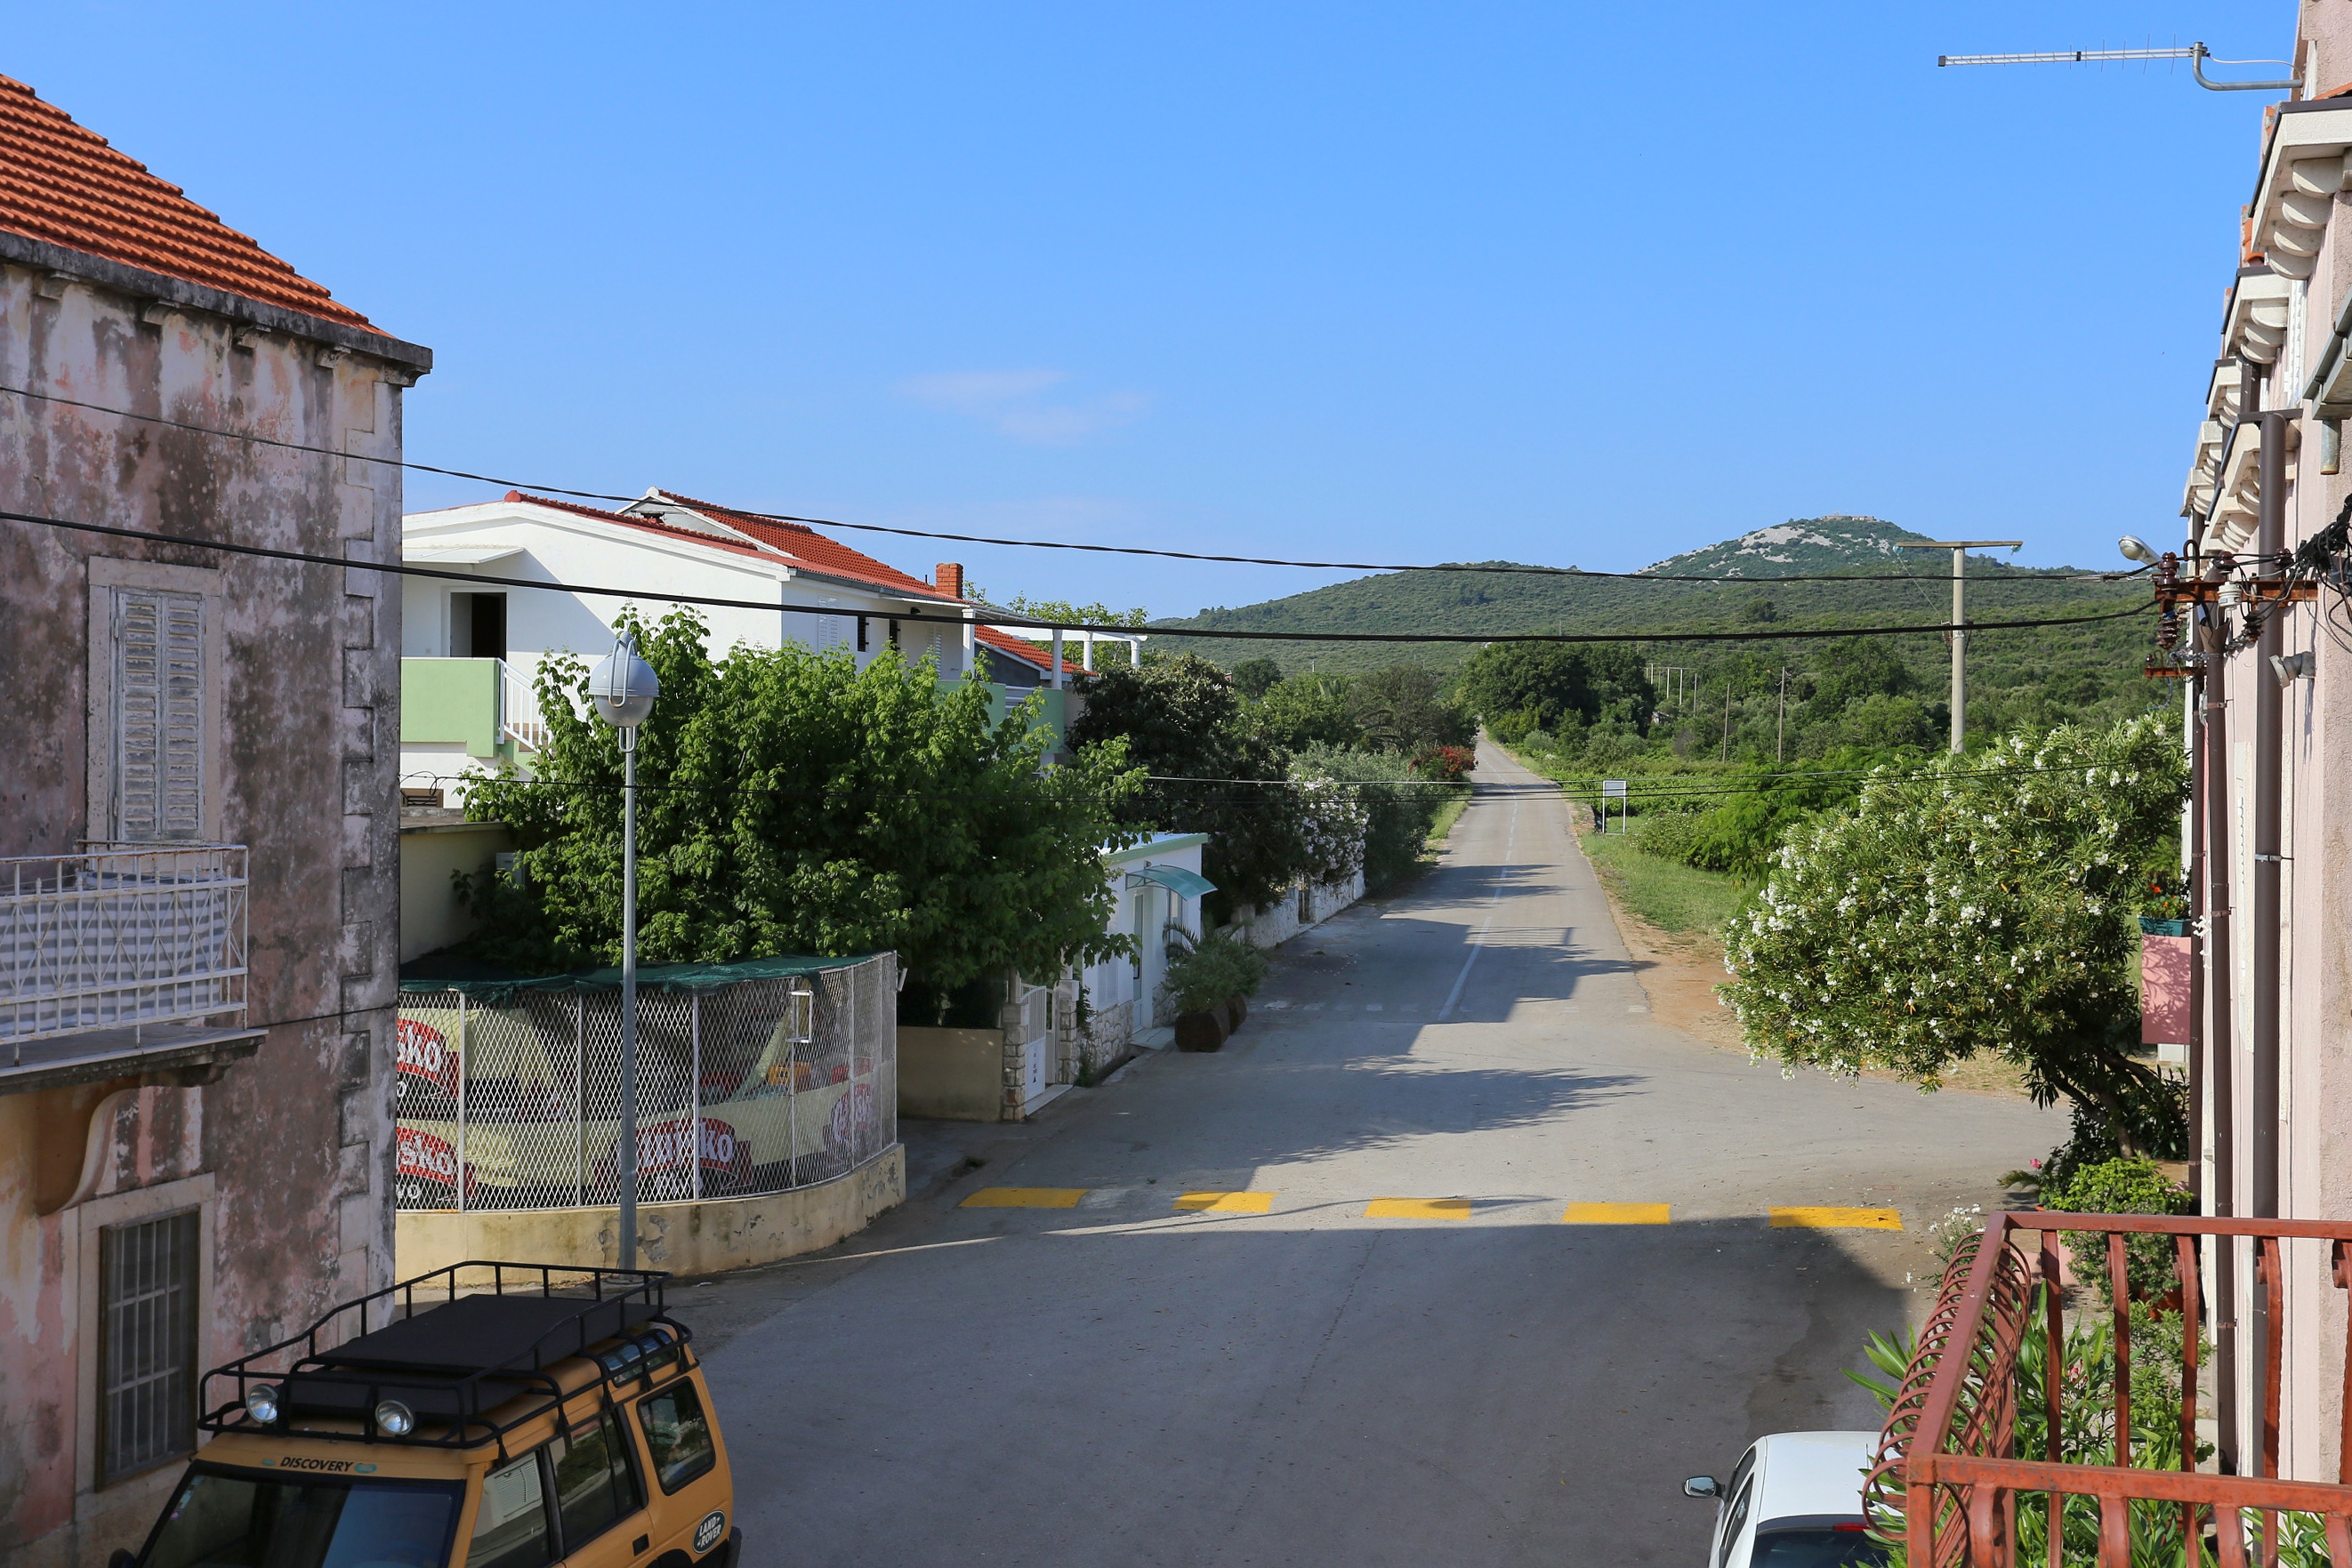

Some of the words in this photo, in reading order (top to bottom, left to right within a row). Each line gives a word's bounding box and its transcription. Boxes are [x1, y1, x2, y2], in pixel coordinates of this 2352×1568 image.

[397, 1024, 442, 1073] sko
[397, 1135, 455, 1176] sko
[396, 1183, 422, 1200] vo
[280, 1457, 353, 1472] DISCOVERY
[699, 1516, 717, 1538] LAND
[700, 1524, 721, 1548] ROVER
